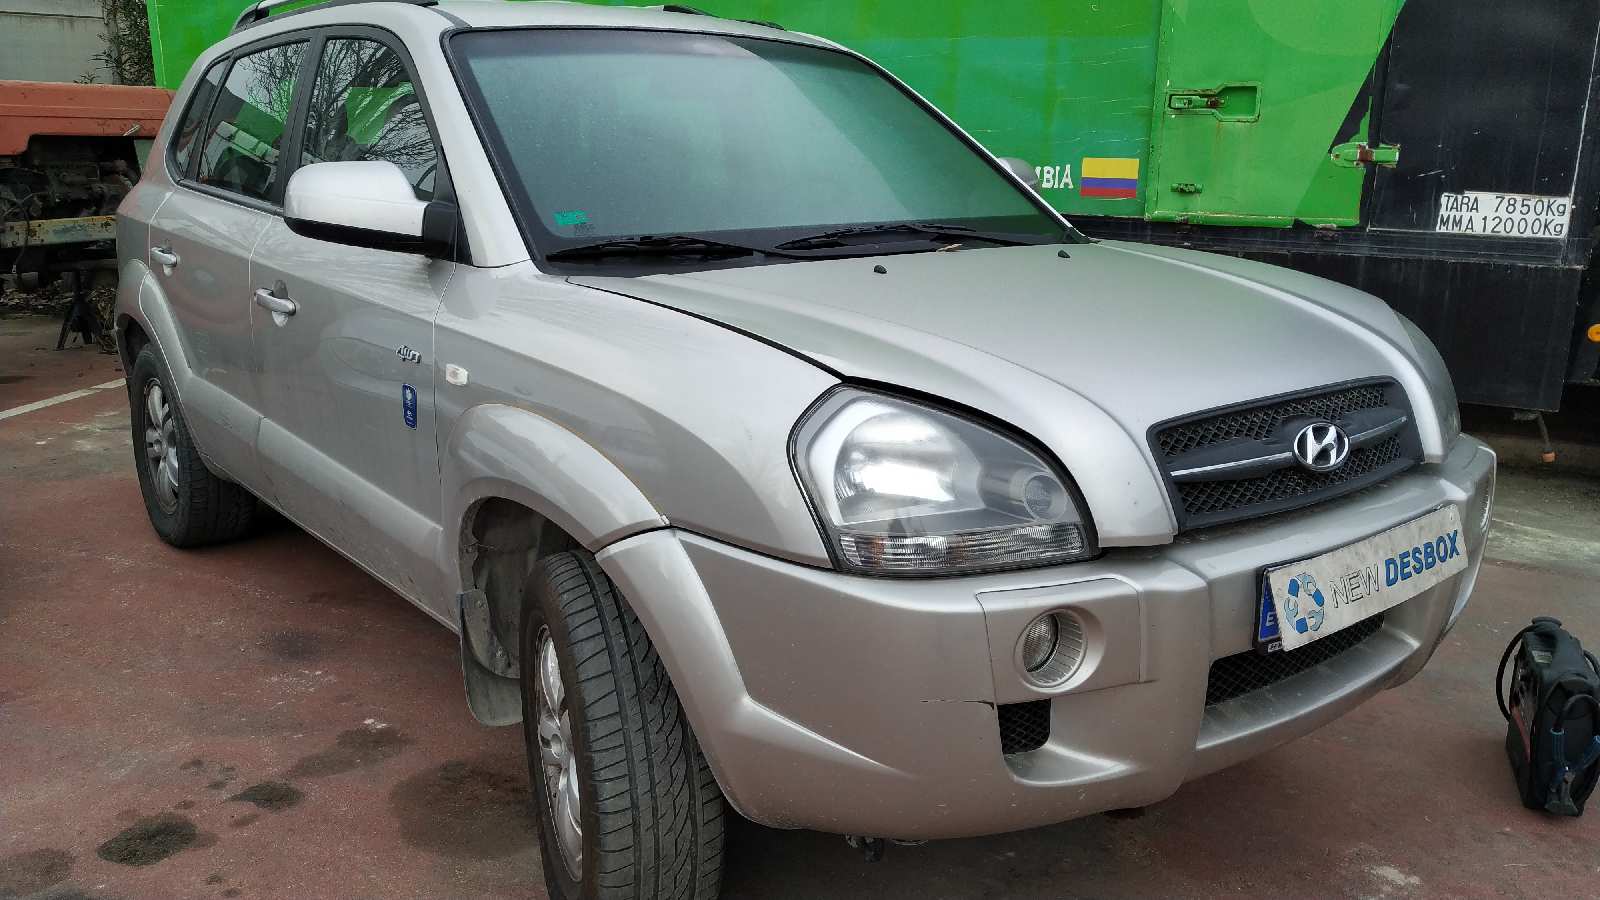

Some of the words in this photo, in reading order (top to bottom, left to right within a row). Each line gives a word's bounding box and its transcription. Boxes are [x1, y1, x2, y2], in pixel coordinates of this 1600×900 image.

[1443, 194, 1479, 213] TARA
[1494, 195, 1567, 217] 7850Kg
[1481, 215, 1565, 236] 12000Kg
[1330, 563, 1380, 608] NEW
[1385, 529, 1461, 587] DESBOX
[1265, 611, 1276, 627] E
